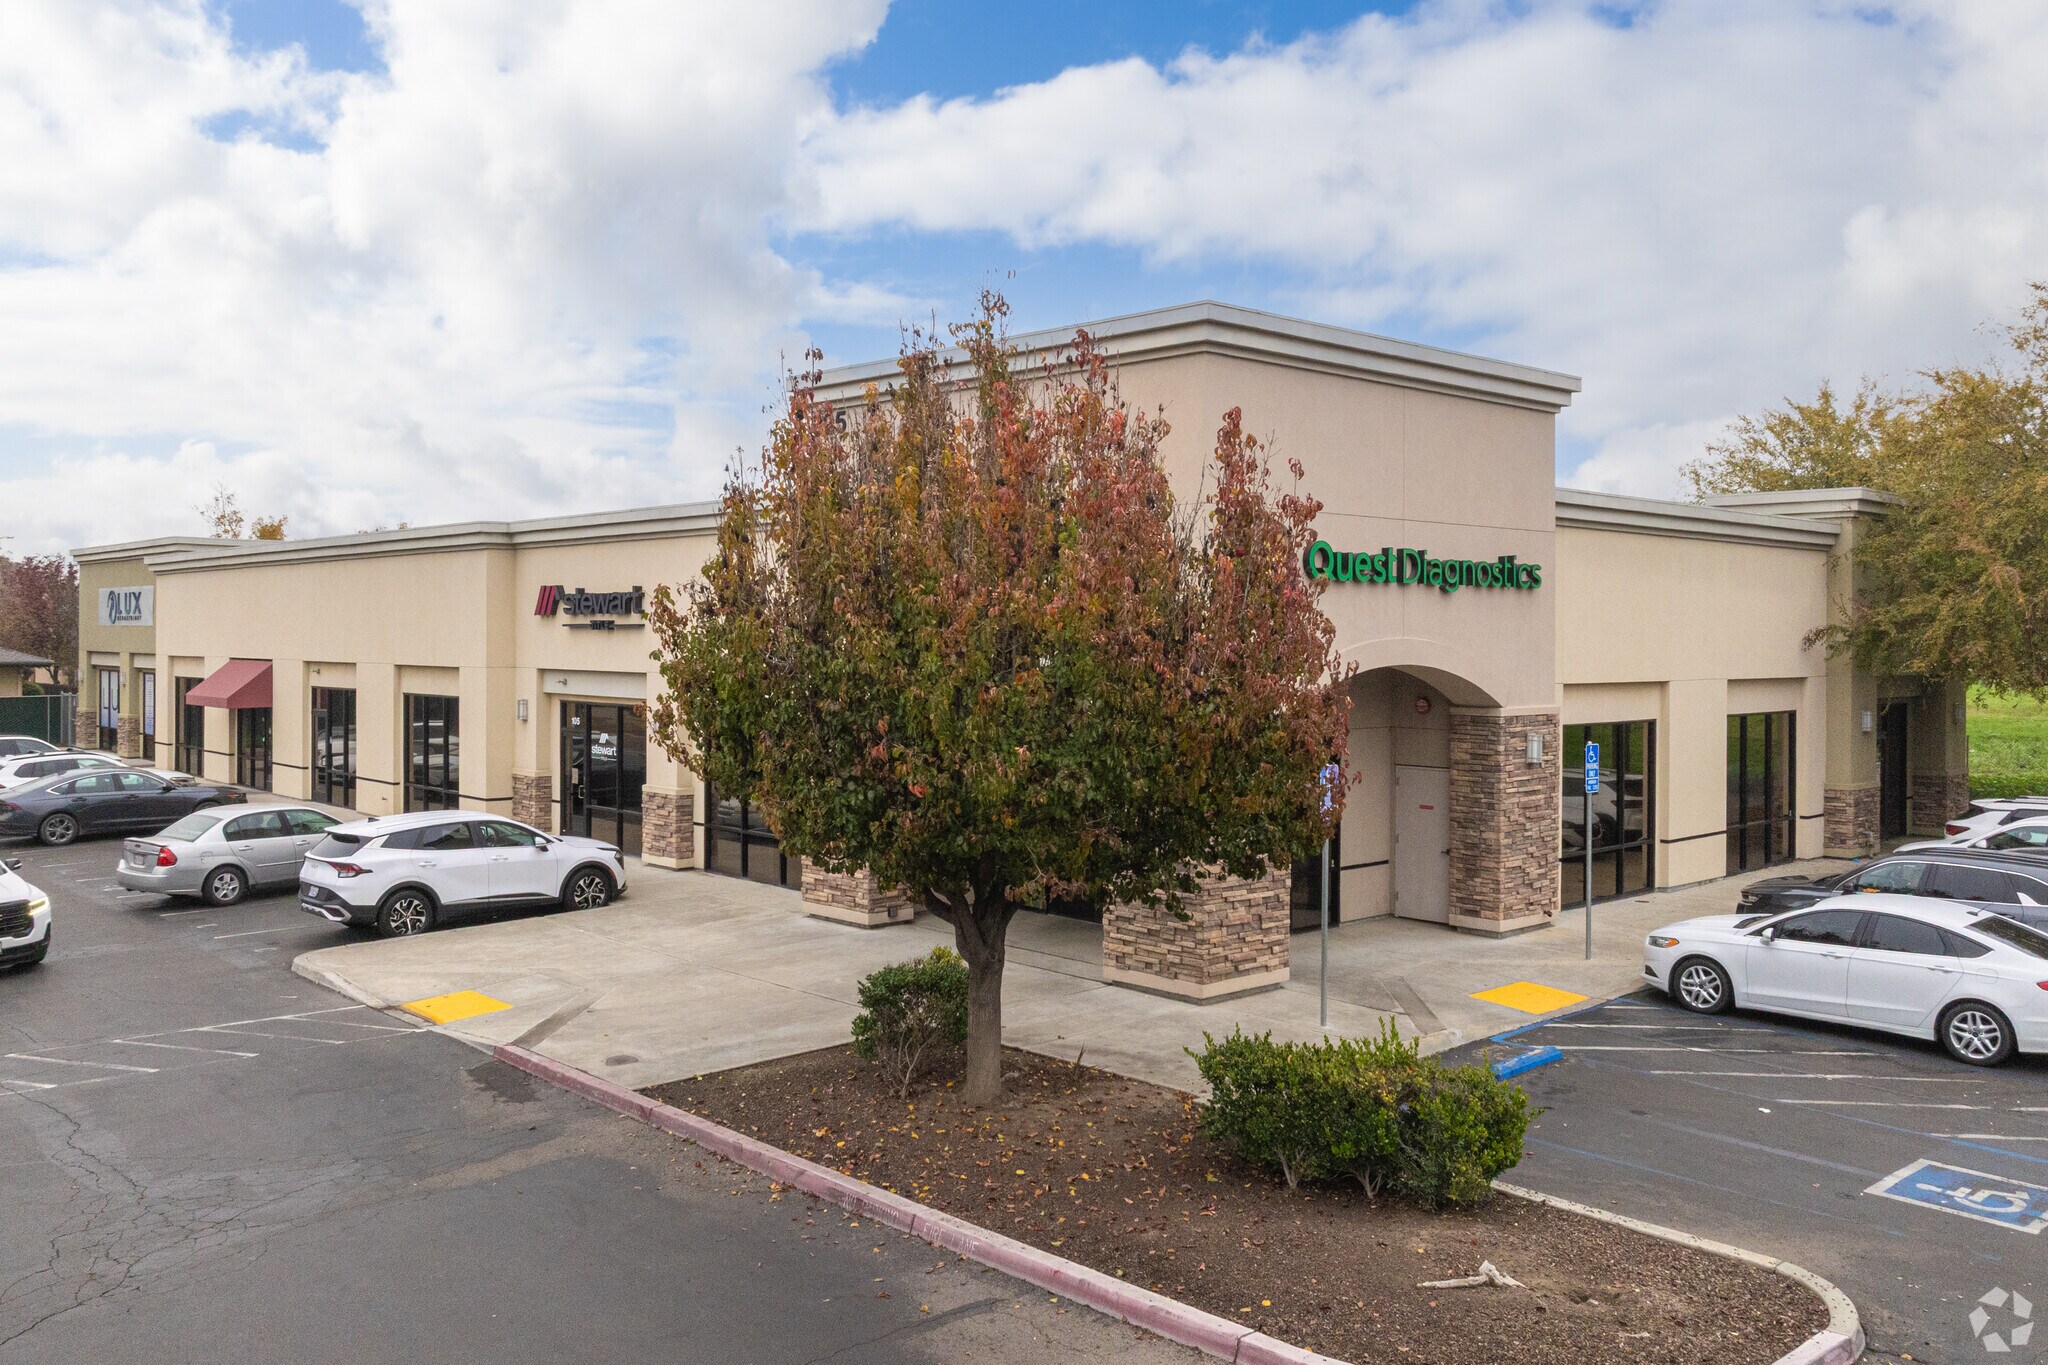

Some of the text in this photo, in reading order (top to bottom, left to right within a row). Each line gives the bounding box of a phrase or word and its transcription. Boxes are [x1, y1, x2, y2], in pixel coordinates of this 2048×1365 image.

[1304, 540, 1542, 593] Quest Diagnostics
[117, 591, 142, 615] LUX
[562, 586, 646, 616] stewart
[571, 716, 581, 726] 105
[591, 744, 617, 756] stewart
